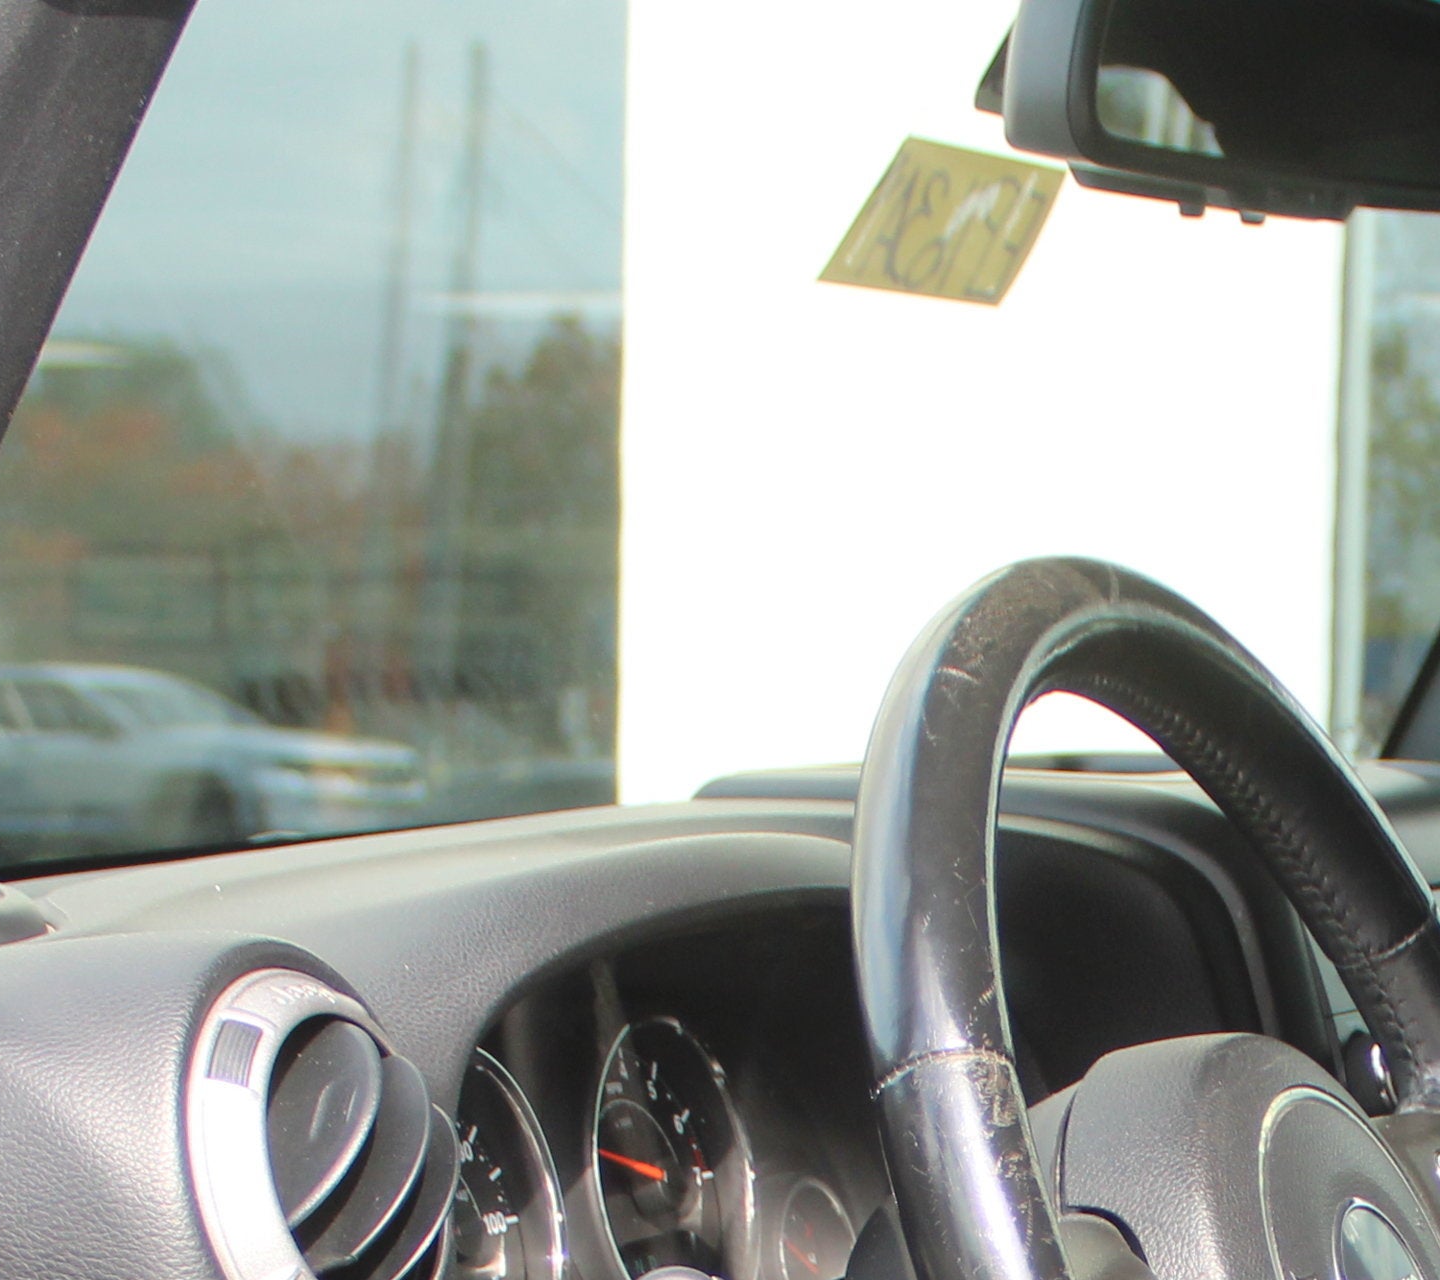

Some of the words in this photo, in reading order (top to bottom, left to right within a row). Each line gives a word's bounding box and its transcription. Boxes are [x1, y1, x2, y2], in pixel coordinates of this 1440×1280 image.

[646, 1080, 658, 1100] 5
[673, 1114, 685, 1135] 6
[691, 1166, 703, 1187] 7
[483, 1211, 508, 1235] 100
